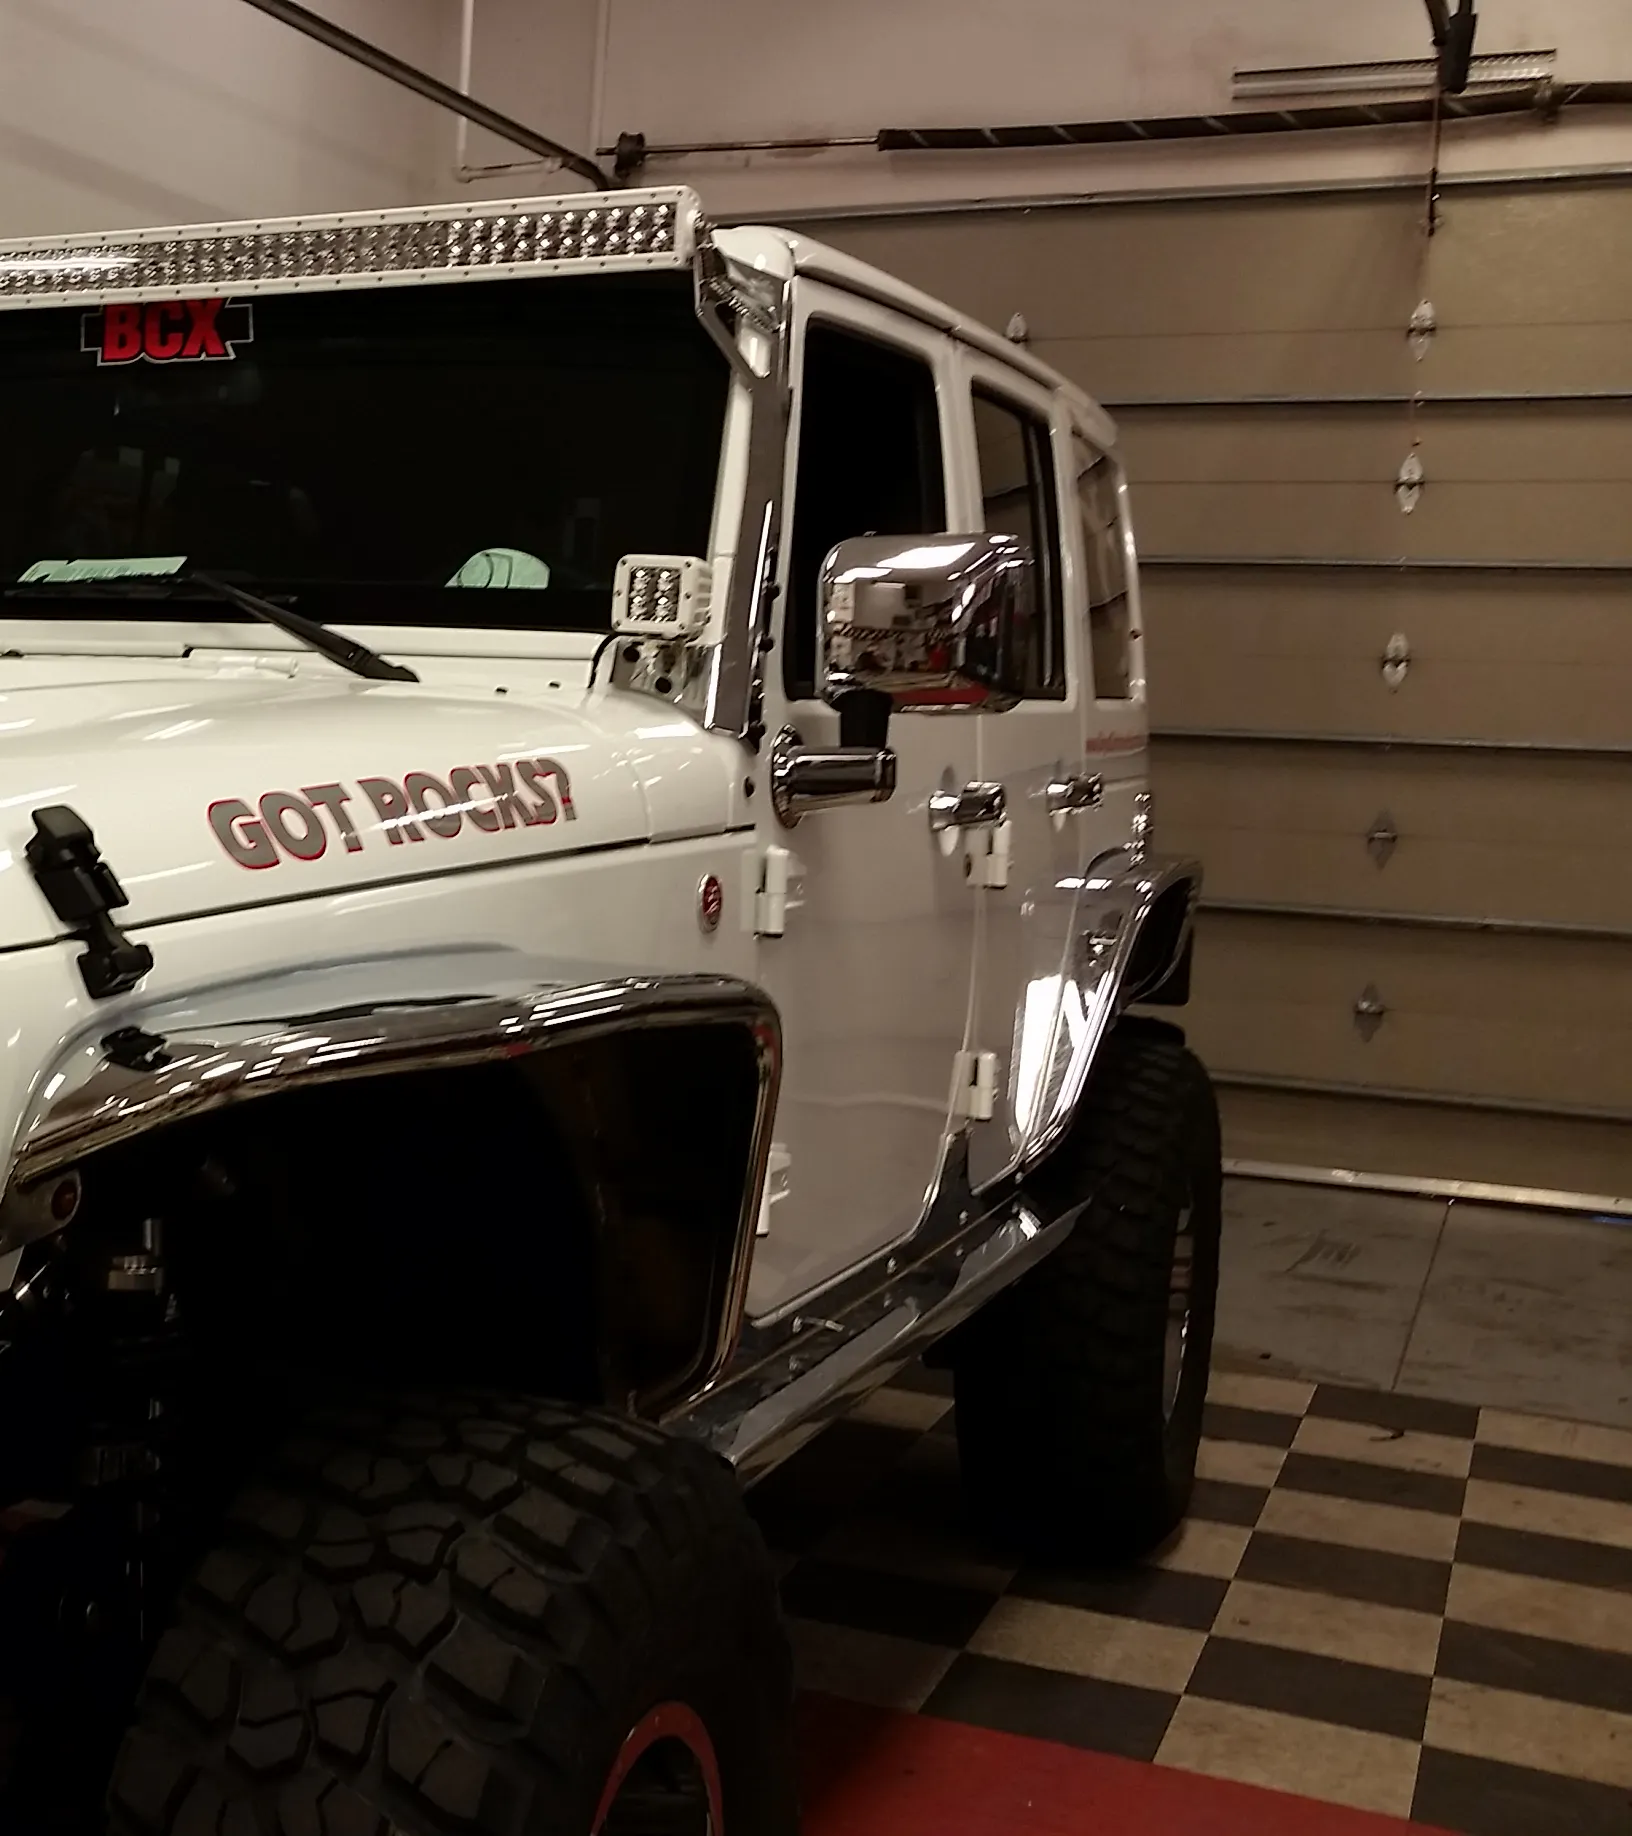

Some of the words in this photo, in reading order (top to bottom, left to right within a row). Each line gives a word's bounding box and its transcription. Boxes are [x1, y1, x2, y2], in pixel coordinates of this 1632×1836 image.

[103, 298, 226, 360] BCX
[208, 783, 363, 869] GOT
[357, 758, 576, 845] ROCKS?
